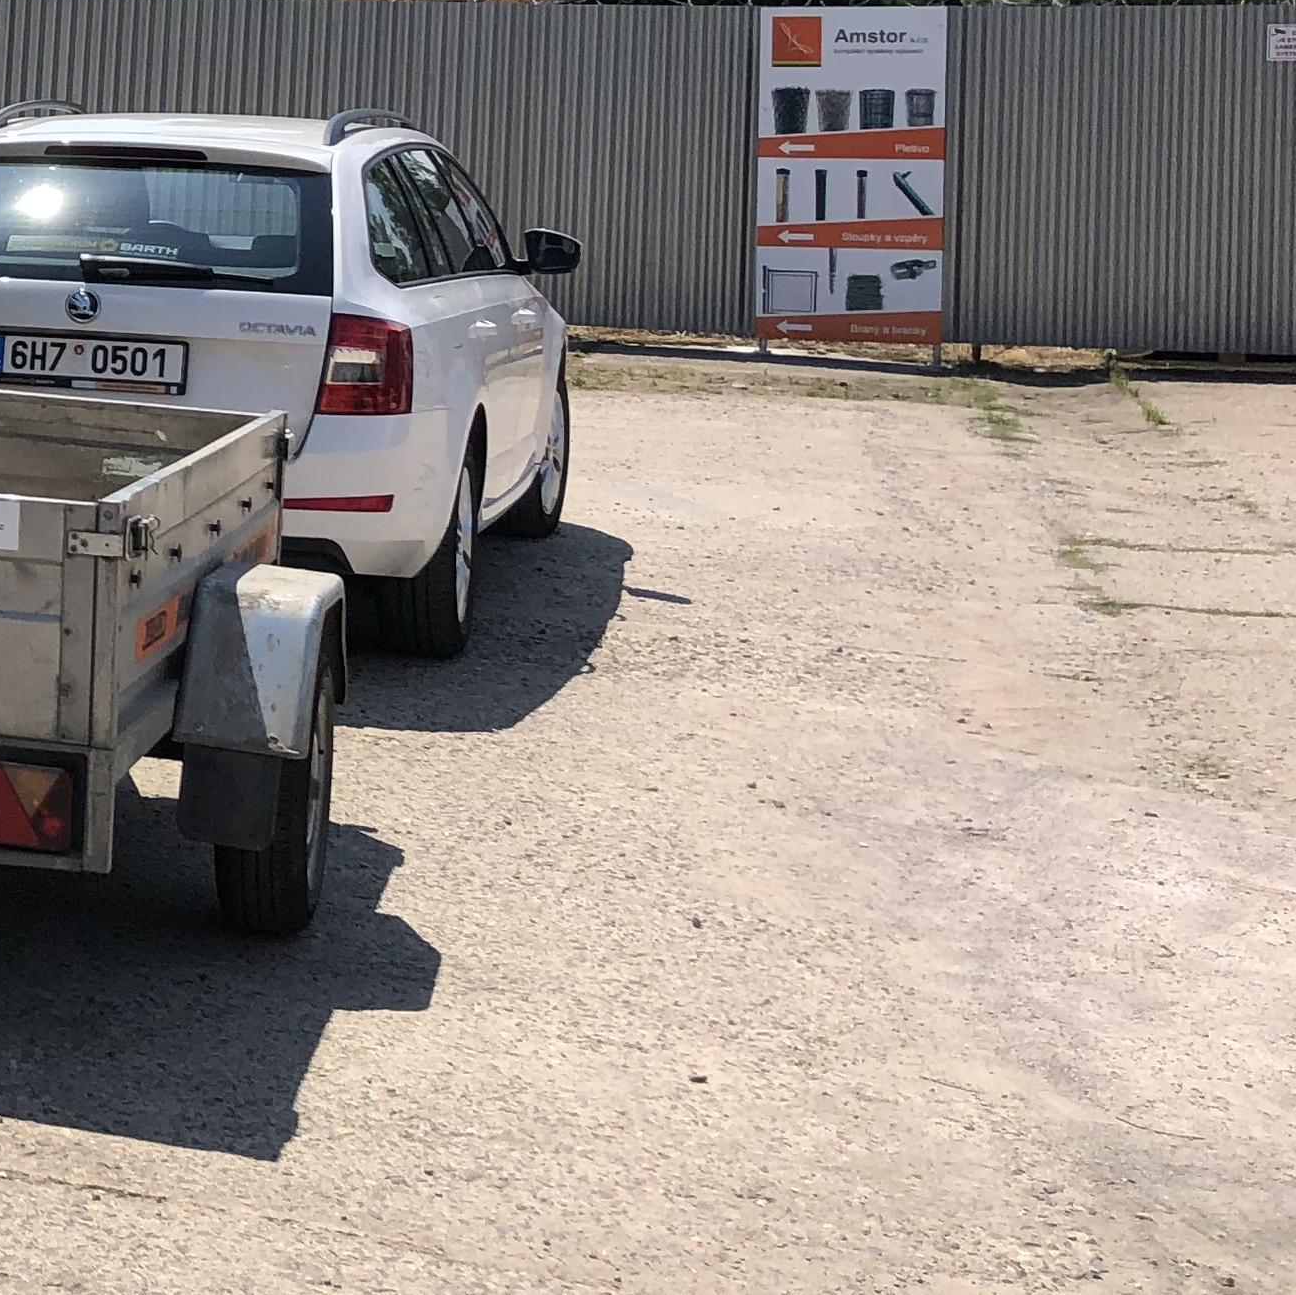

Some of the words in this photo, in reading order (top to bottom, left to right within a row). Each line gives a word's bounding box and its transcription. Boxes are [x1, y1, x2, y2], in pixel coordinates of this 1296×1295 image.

[834, 28, 907, 44] Amstor
[119, 242, 178, 256] BARTH
[238, 321, 317, 337] OCTAVIA
[10, 340, 67, 372] 6H7
[91, 344, 167, 378] 0501
